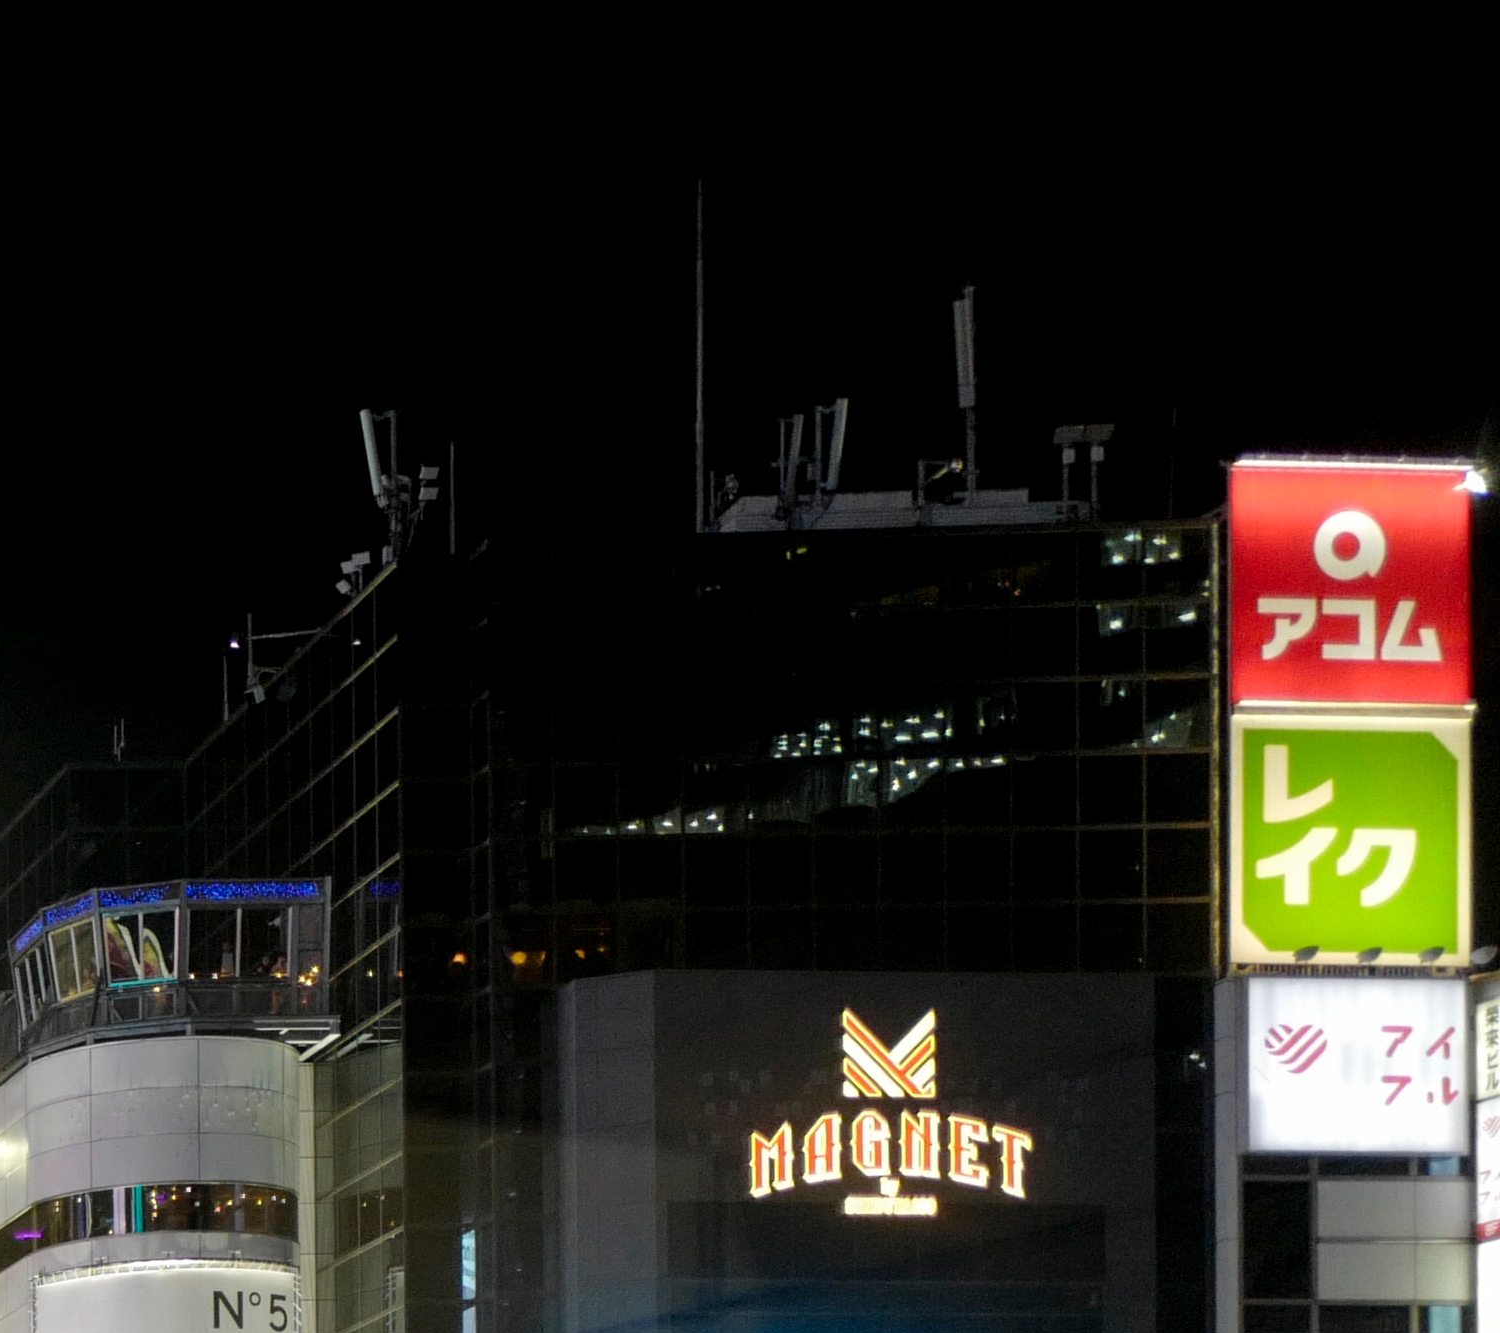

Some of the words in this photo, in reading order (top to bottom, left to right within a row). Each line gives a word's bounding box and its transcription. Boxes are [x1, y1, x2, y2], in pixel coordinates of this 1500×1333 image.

[1256, 597, 1442, 662] アコム
[1255, 743, 1418, 908] レイク
[748, 1110, 1032, 1199] MAGNET
